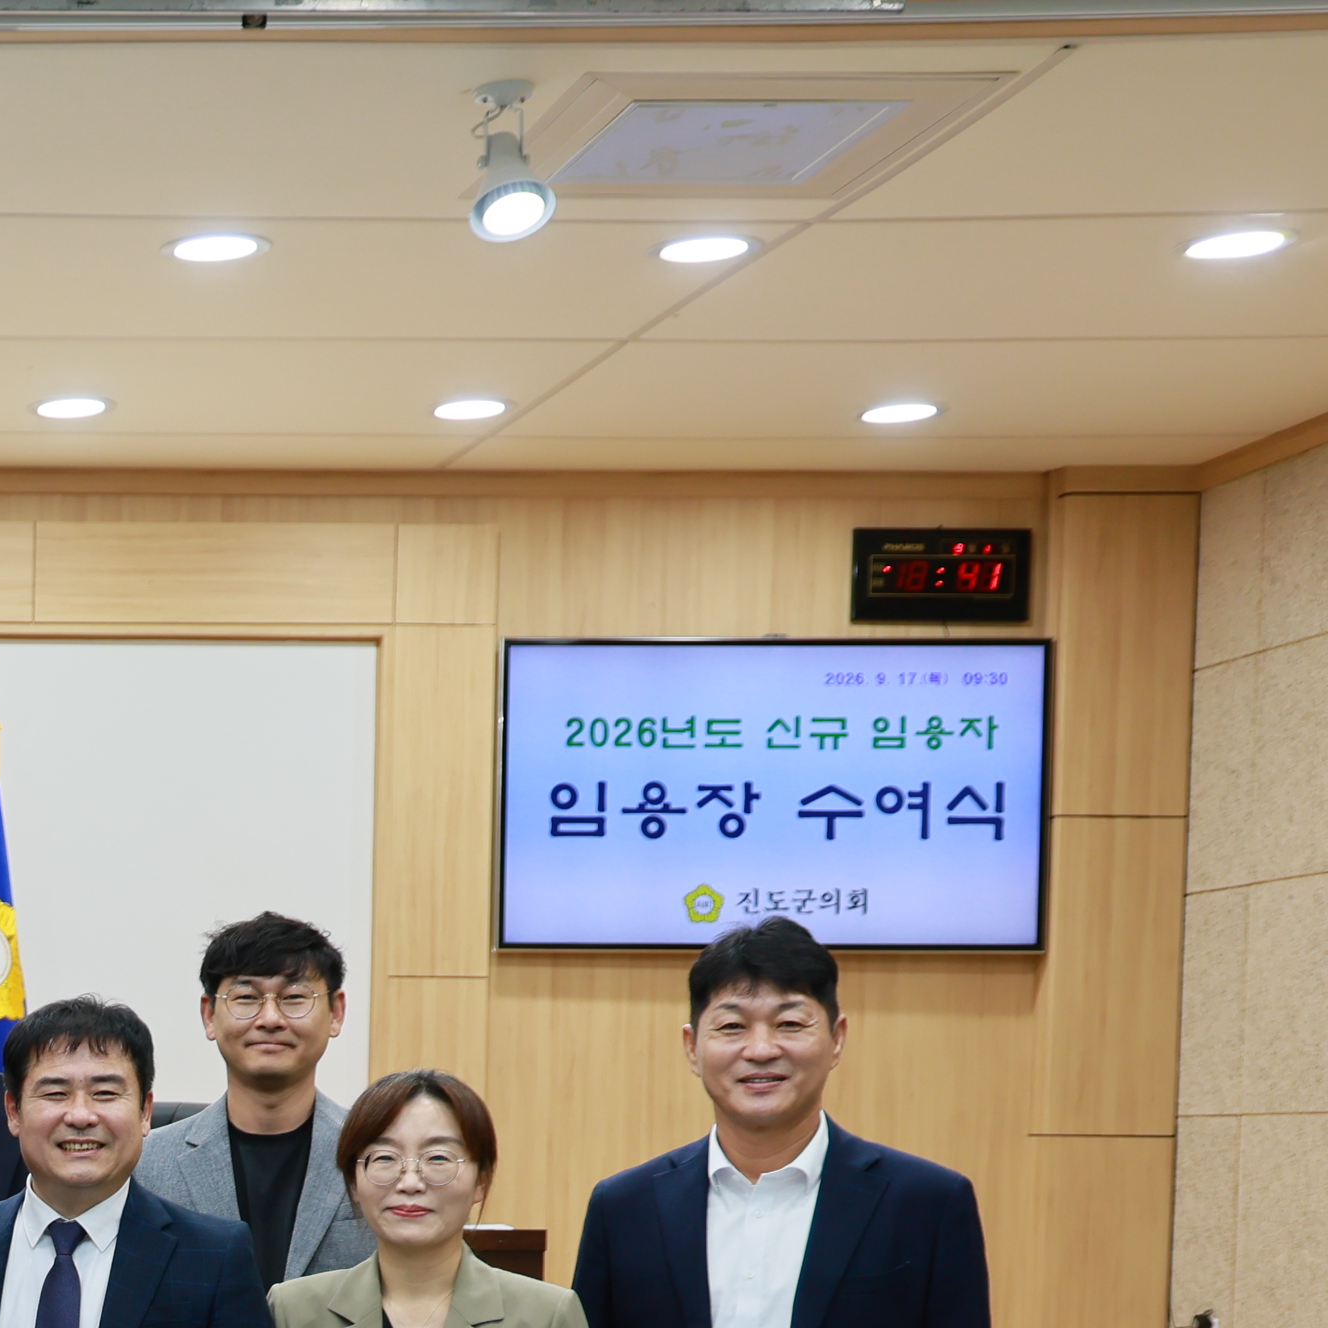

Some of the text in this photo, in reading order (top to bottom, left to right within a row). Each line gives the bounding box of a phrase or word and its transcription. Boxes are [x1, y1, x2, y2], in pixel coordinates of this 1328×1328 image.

[824, 672, 869, 686] 2026.
[963, 671, 1008, 686] 09:30
[564, 715, 999, 750] 2026년도 신규 임용자
[549, 781, 1006, 841] 임용장 수여식
[735, 887, 869, 915] 진도군의회
